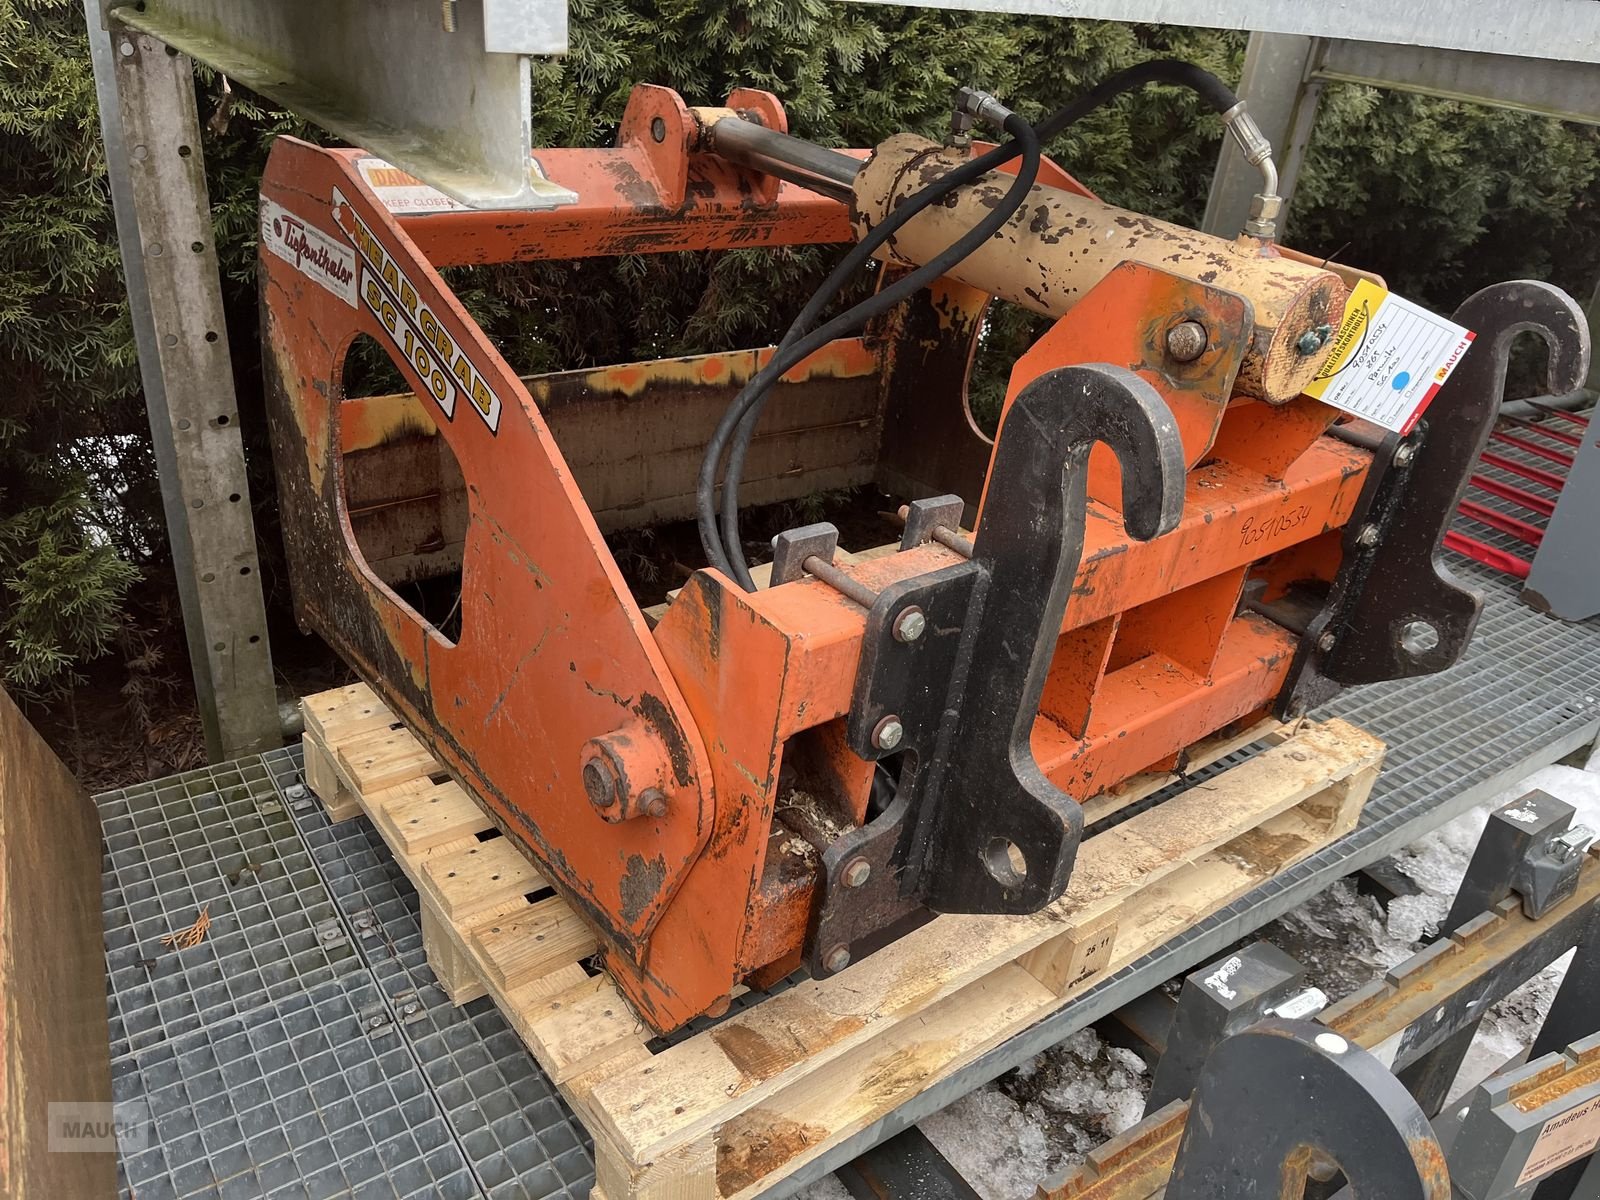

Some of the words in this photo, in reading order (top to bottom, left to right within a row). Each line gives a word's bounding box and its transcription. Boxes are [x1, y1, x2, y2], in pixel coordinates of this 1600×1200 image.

[384, 199, 410, 208] KEEP
[340, 202, 493, 416] HEARGRAB
[1335, 307, 1361, 346] MASCHINEN
[366, 280, 398, 334] SG
[404, 329, 446, 401] 100
[1438, 341, 1467, 378] MAUCH
[1376, 375, 1388, 387] SG
[1239, 505, 1312, 549] 90510534
[1541, 1106, 1589, 1136] Amadeus
